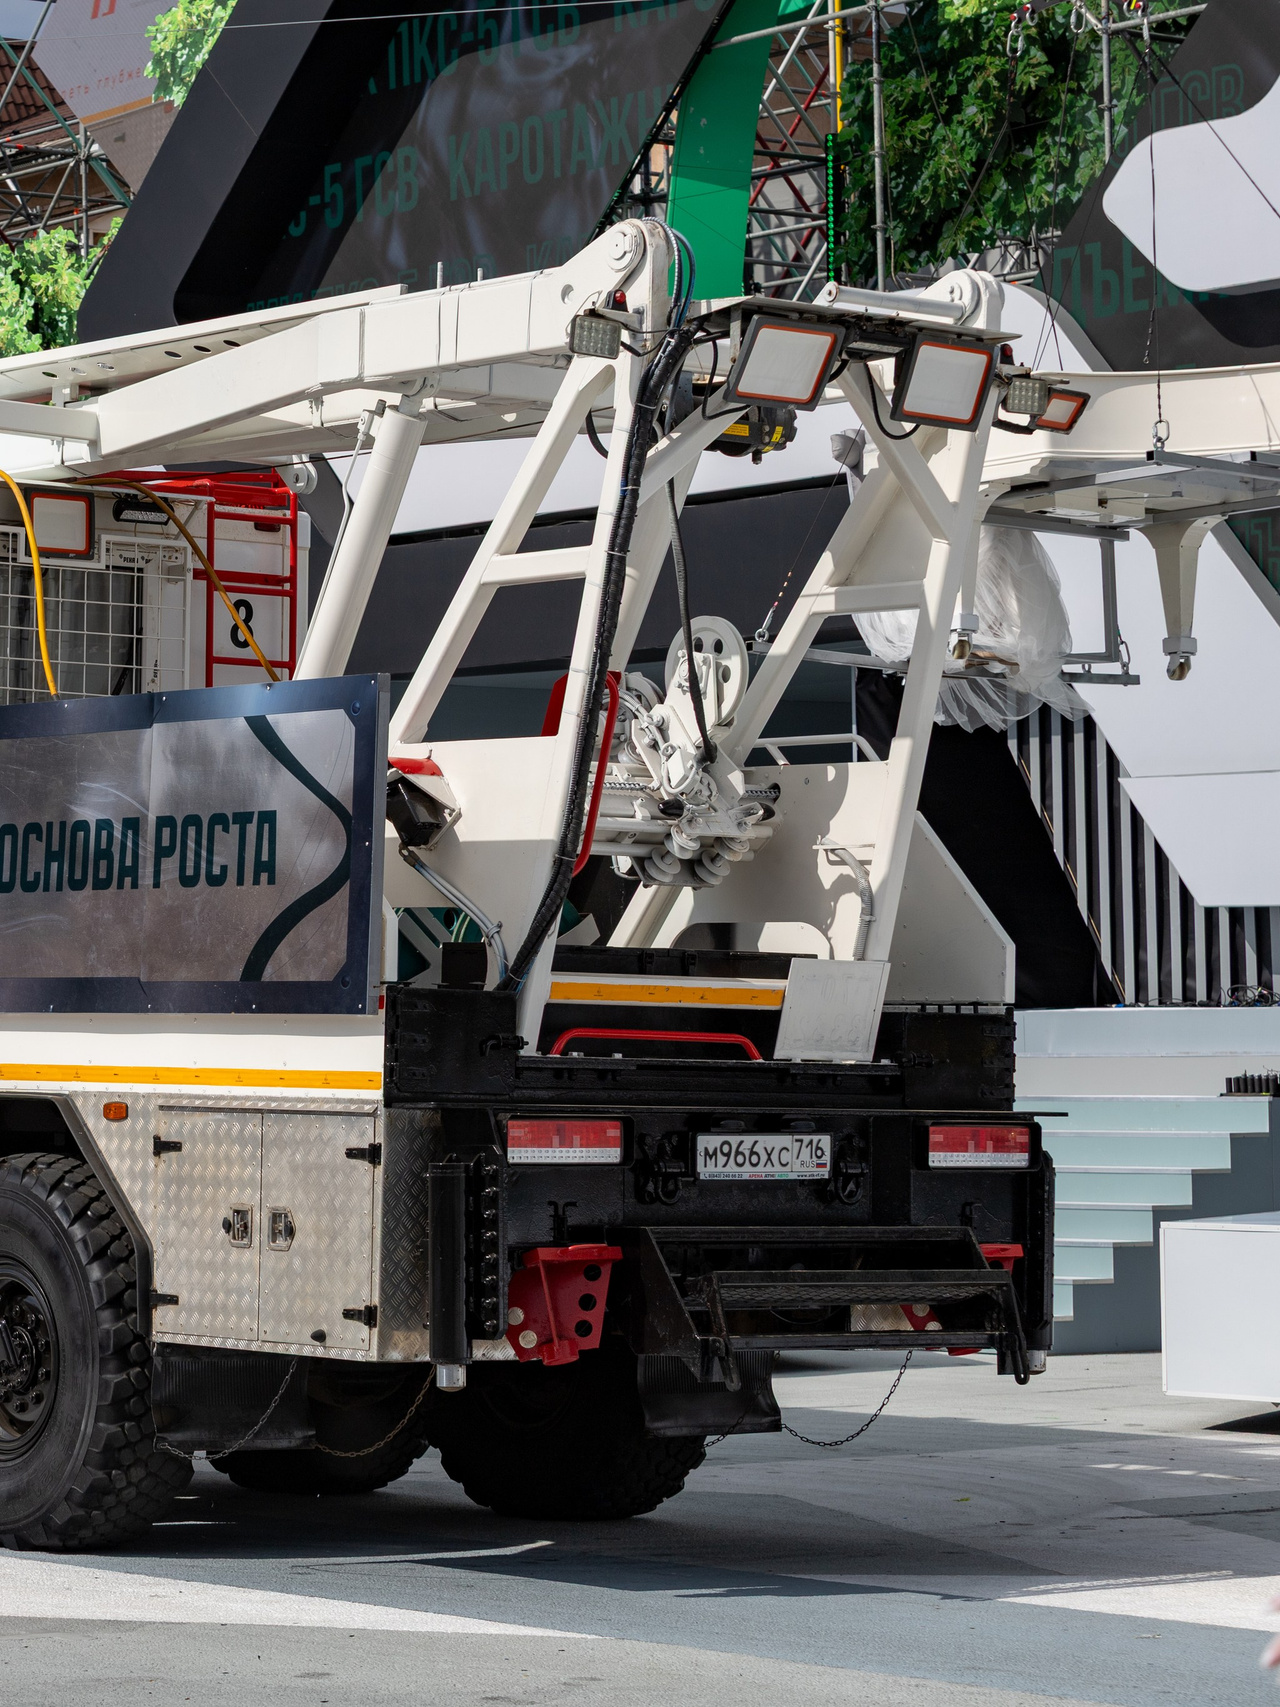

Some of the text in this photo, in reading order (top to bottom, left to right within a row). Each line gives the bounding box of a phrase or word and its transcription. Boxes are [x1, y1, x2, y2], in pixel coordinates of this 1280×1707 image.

[354, 145, 419, 223] ГСВ
[230, 598, 254, 649] 8
[152, 809, 277, 889] РОСТА
[794, 1138, 825, 1160] 716
[800, 1160, 816, 1168] RUS
